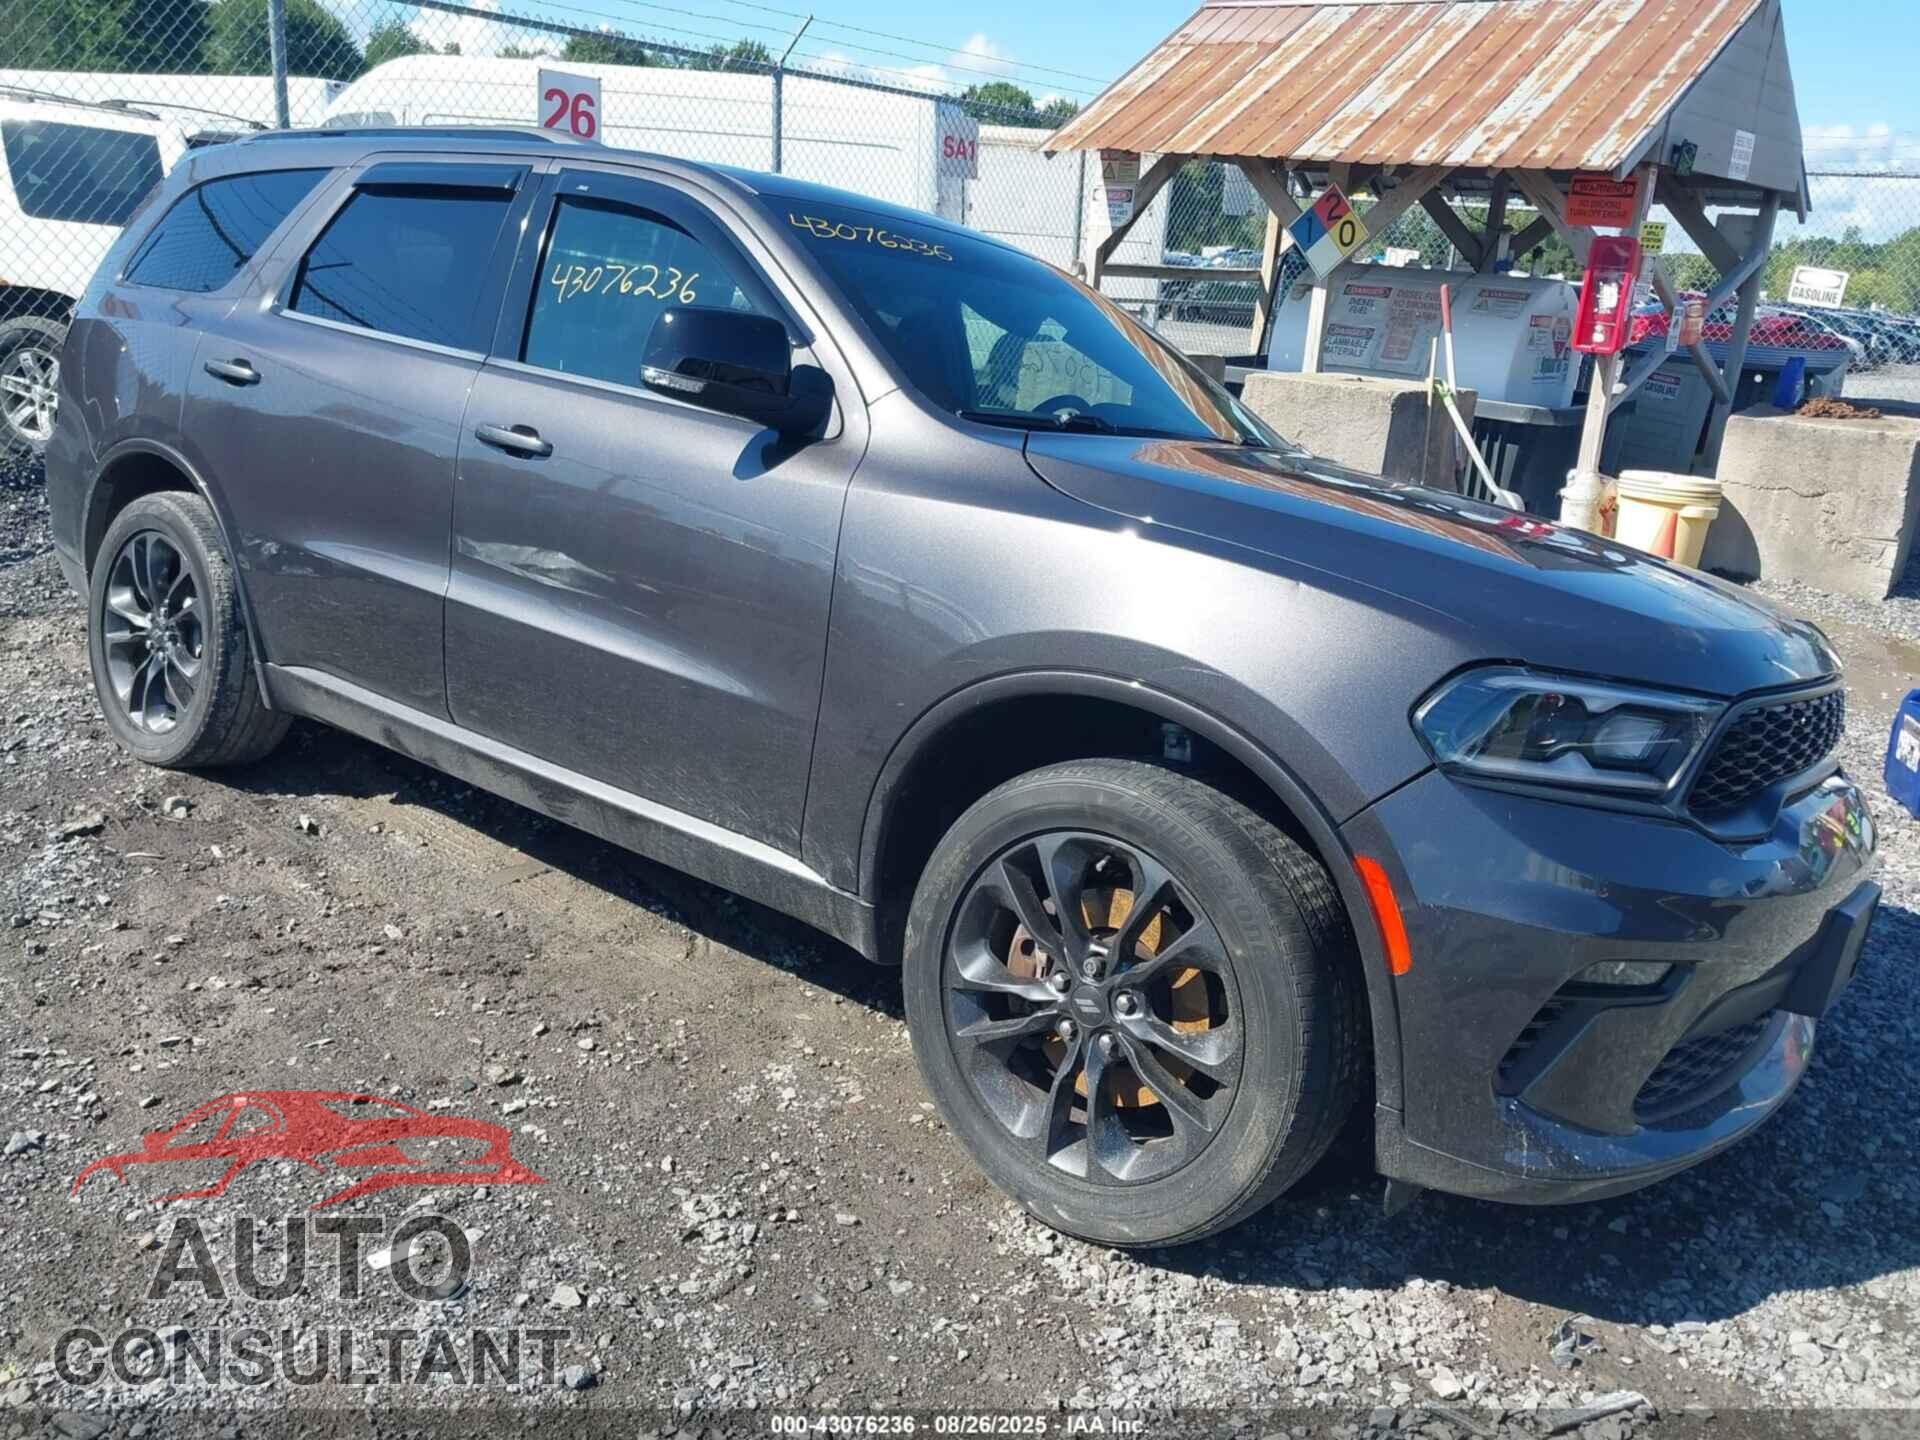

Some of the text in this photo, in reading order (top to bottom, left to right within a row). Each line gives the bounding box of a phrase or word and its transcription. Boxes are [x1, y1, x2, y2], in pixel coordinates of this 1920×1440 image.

[544, 88, 596, 138] 26
[943, 135, 976, 161] SA1
[1325, 192, 1344, 221] 2
[789, 213, 953, 261] 43076236
[1306, 216, 1314, 244] 1
[1339, 219, 1356, 247] 0
[551, 263, 700, 304] 43076236
[1792, 286, 1839, 304] GASOLINE
